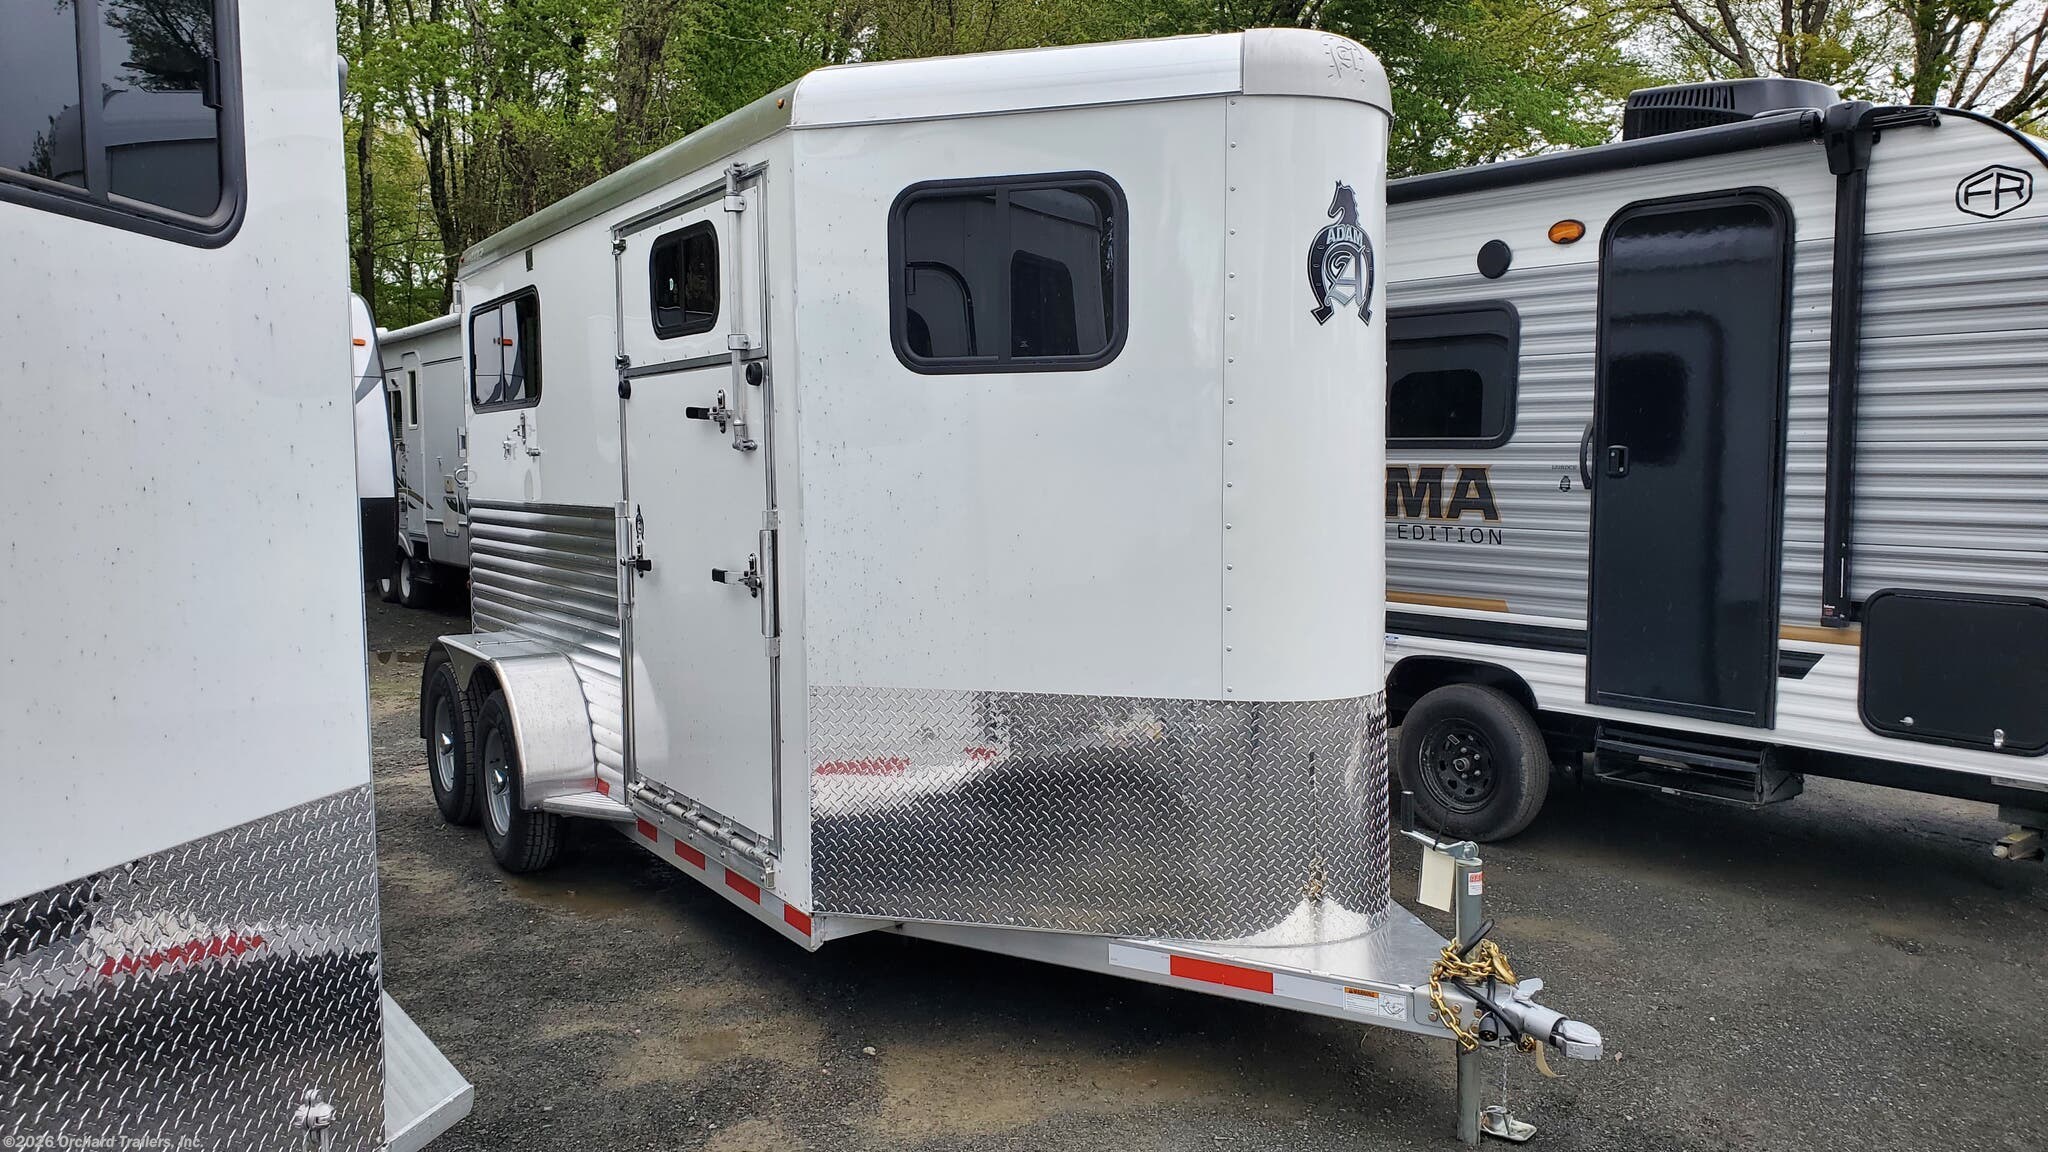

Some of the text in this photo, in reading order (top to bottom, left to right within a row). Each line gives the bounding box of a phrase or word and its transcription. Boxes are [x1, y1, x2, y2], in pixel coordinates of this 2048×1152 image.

[1964, 172, 2024, 210] FR
[1326, 224, 1364, 247] ADAM
[1397, 524, 1502, 545] EDITION
